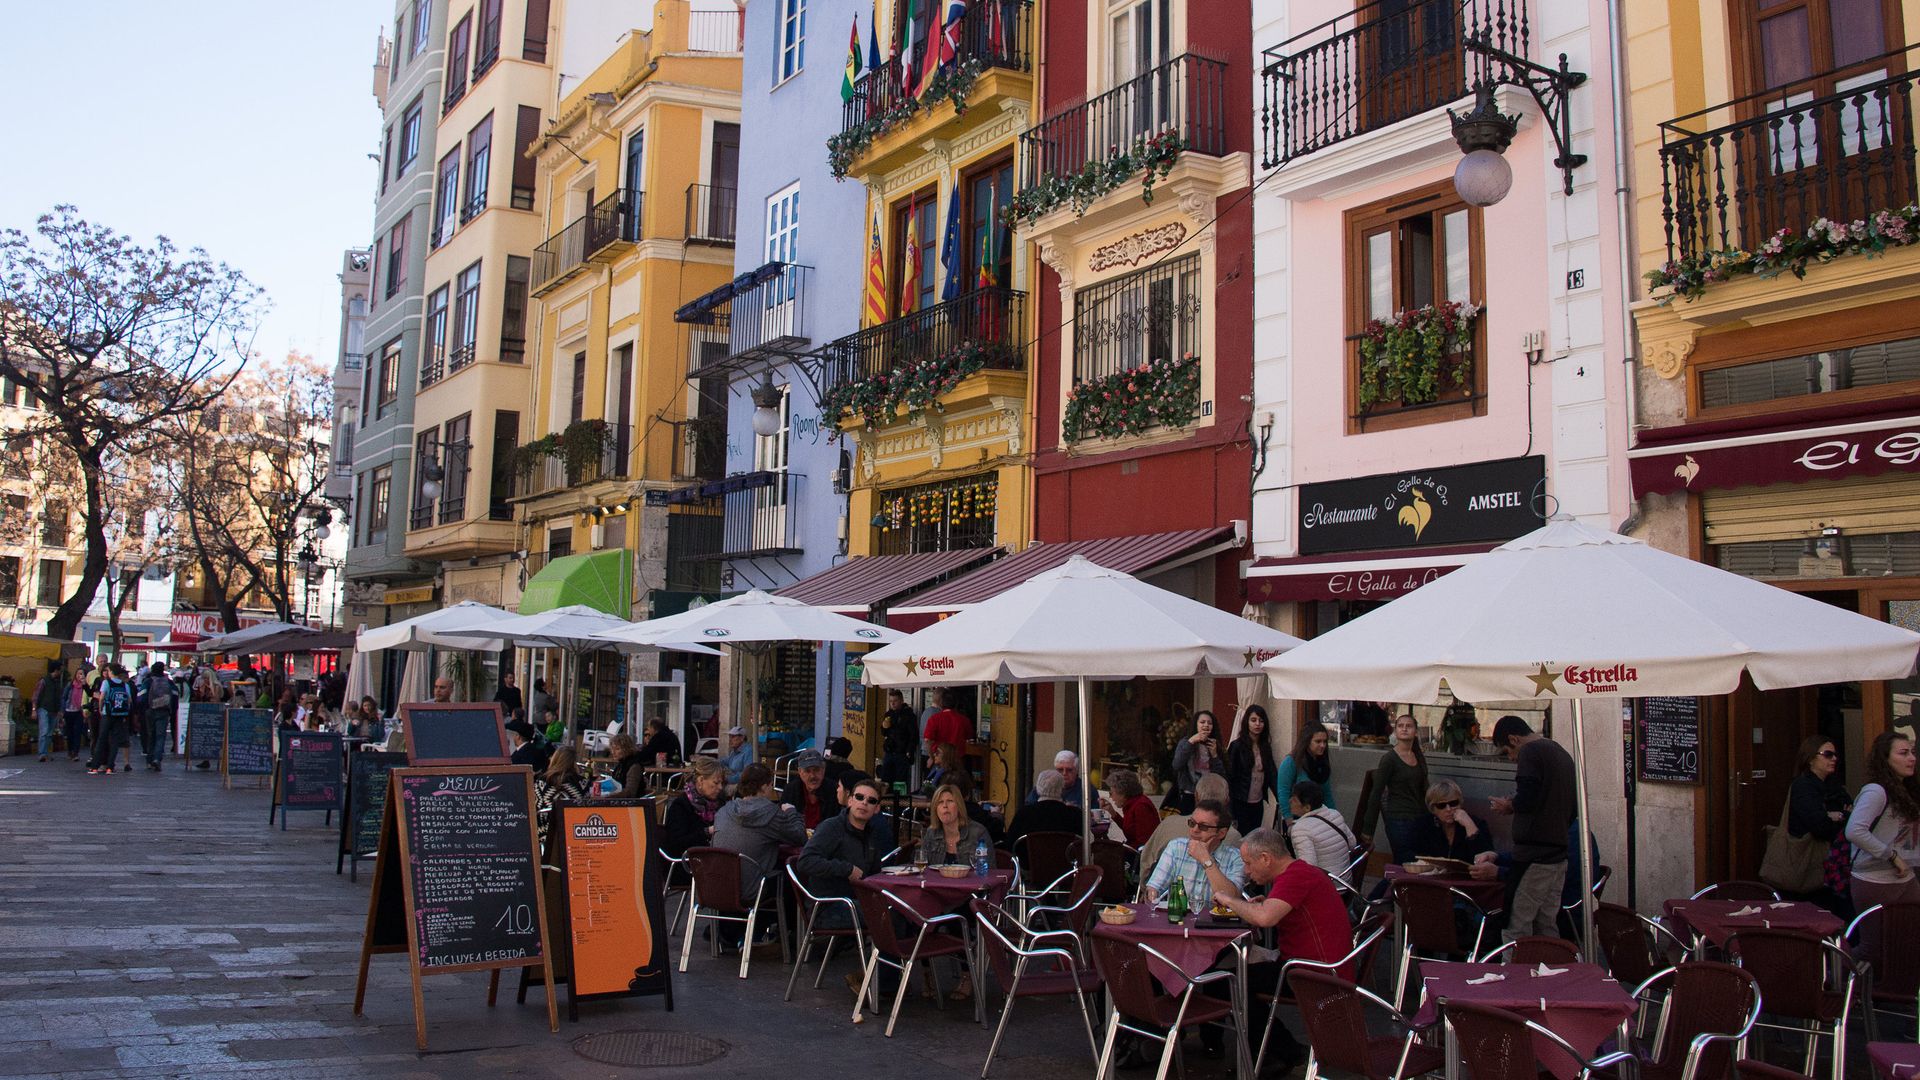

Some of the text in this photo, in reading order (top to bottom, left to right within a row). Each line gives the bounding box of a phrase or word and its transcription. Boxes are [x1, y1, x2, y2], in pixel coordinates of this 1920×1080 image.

[1568, 271, 1584, 289] 13
[1203, 402, 1211, 415] 11
[793, 413, 819, 445] Rooms
[1793, 441, 1860, 470] El
[1384, 476, 1449, 511] El Gallo de Oro
[1468, 491, 1521, 511] AMSTEL
[1303, 503, 1378, 528] Restaurante
[1328, 574, 1352, 594] El
[1358, 571, 1397, 595] Gallo
[1402, 574, 1417, 589] de
[171, 614, 201, 634] PORRAS
[919, 656, 954, 670] Estrella
[1563, 663, 1639, 685] Estrella
[1585, 683, 1618, 694] Damm
[575, 826, 617, 837] CANDELAS
[425, 883, 472, 891] ESCALOPIN
[428, 954, 474, 966] INCLUYE
[485, 948, 526, 959] BEBIDA
